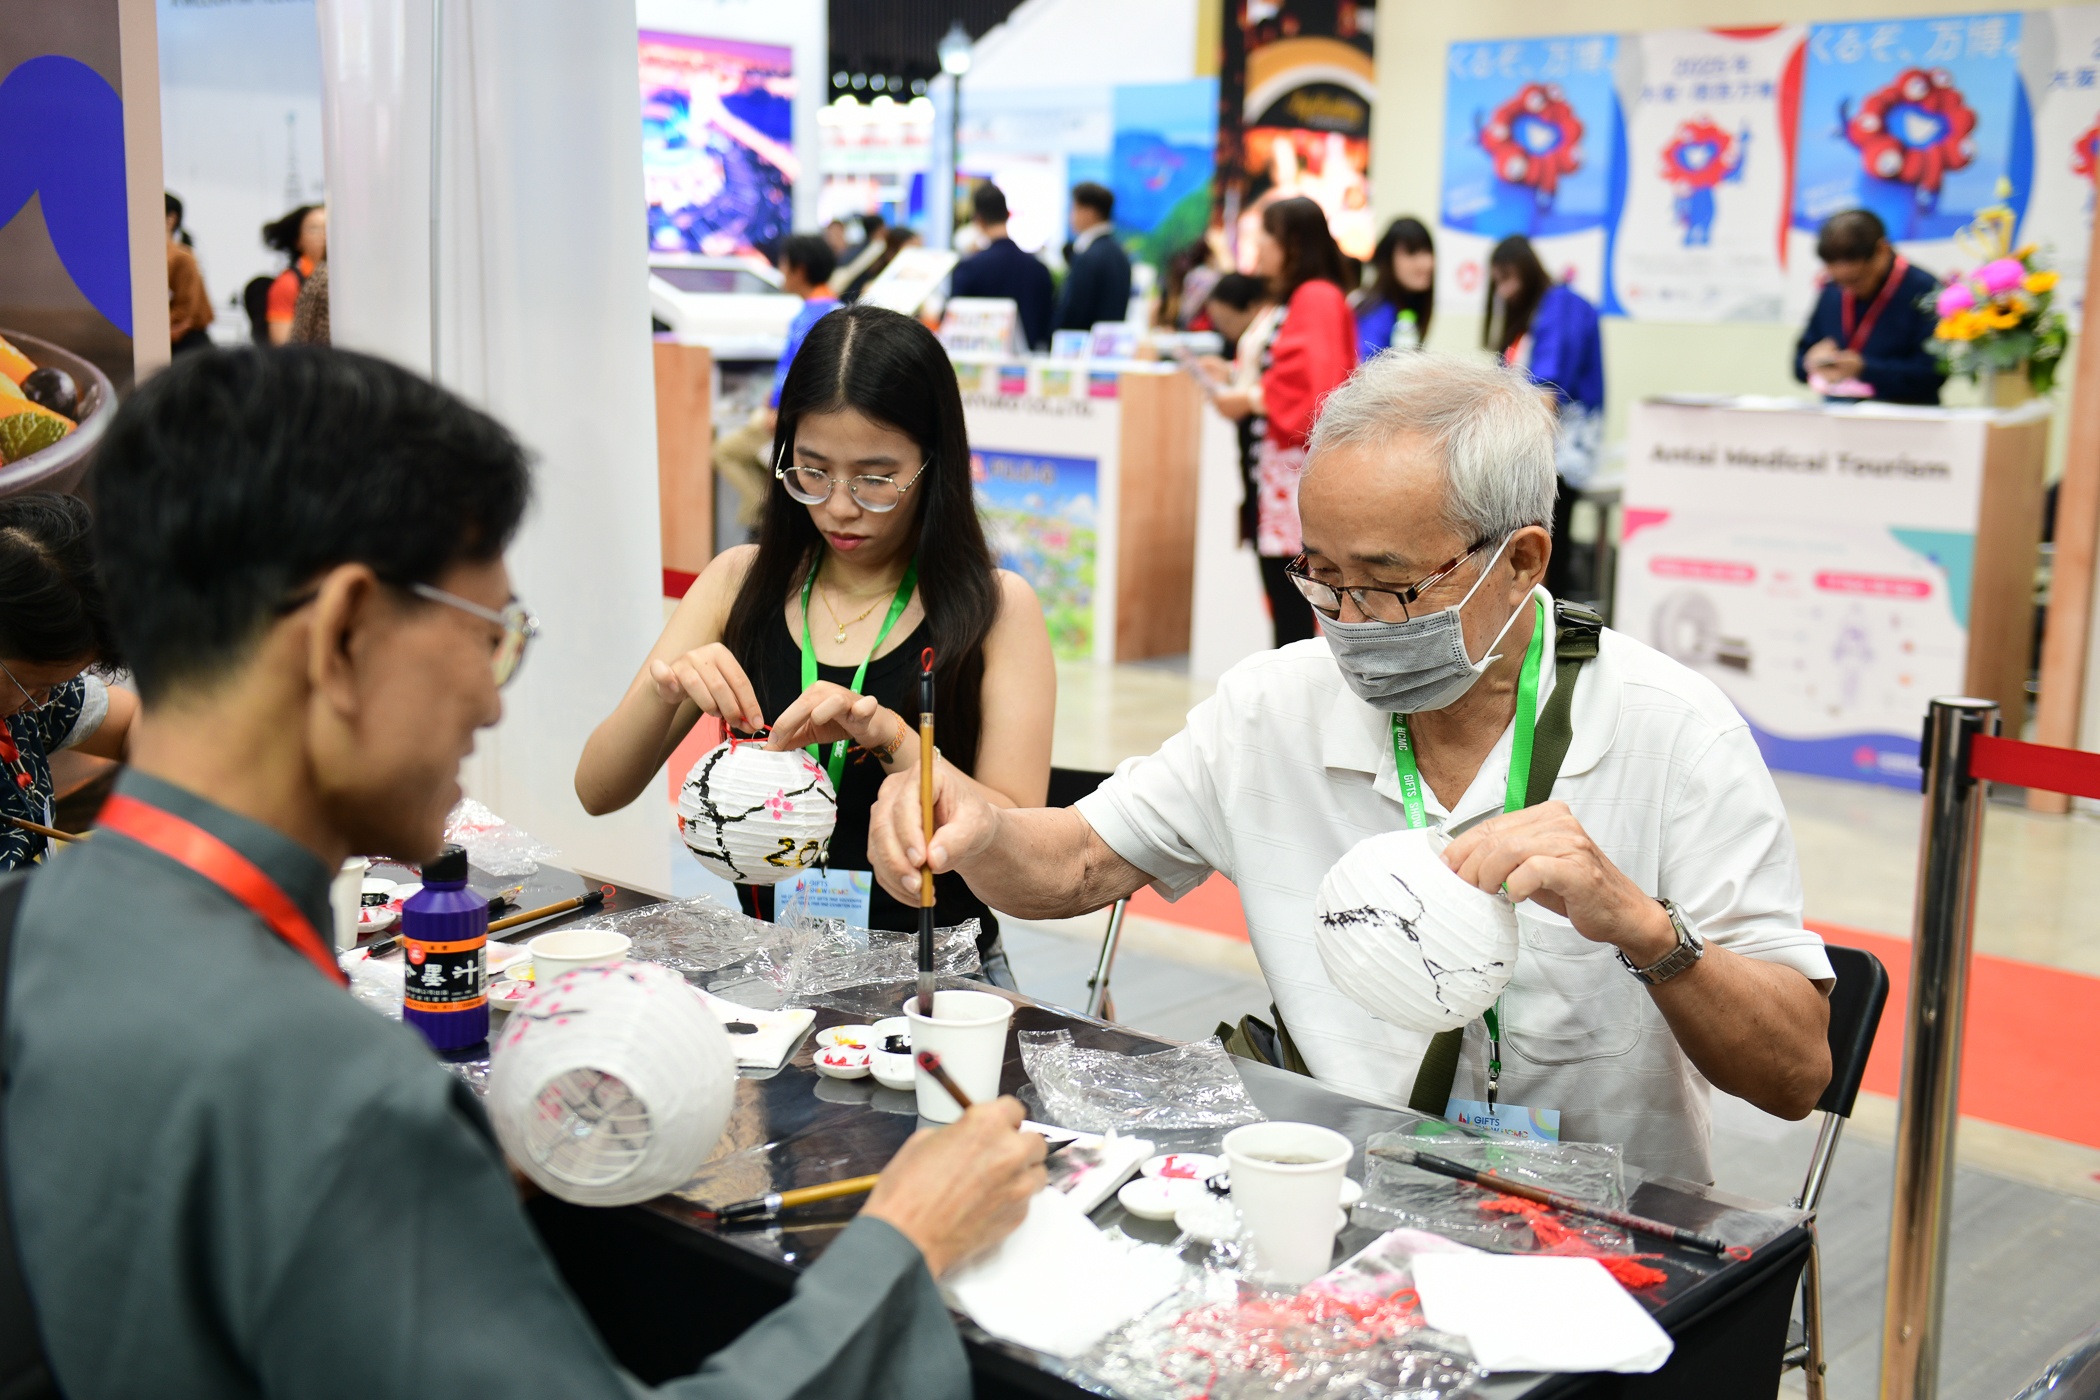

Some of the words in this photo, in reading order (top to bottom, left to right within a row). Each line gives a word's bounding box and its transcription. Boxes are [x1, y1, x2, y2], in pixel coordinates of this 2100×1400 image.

[1726, 448, 1828, 472] Medical
[1837, 452, 1952, 480] Tourism
[1397, 727, 1408, 751] HCMC
[1403, 774, 1417, 798] GIFTS
[1409, 801, 1423, 828] SHOW
[1474, 1115, 1500, 1127] GIFTS
